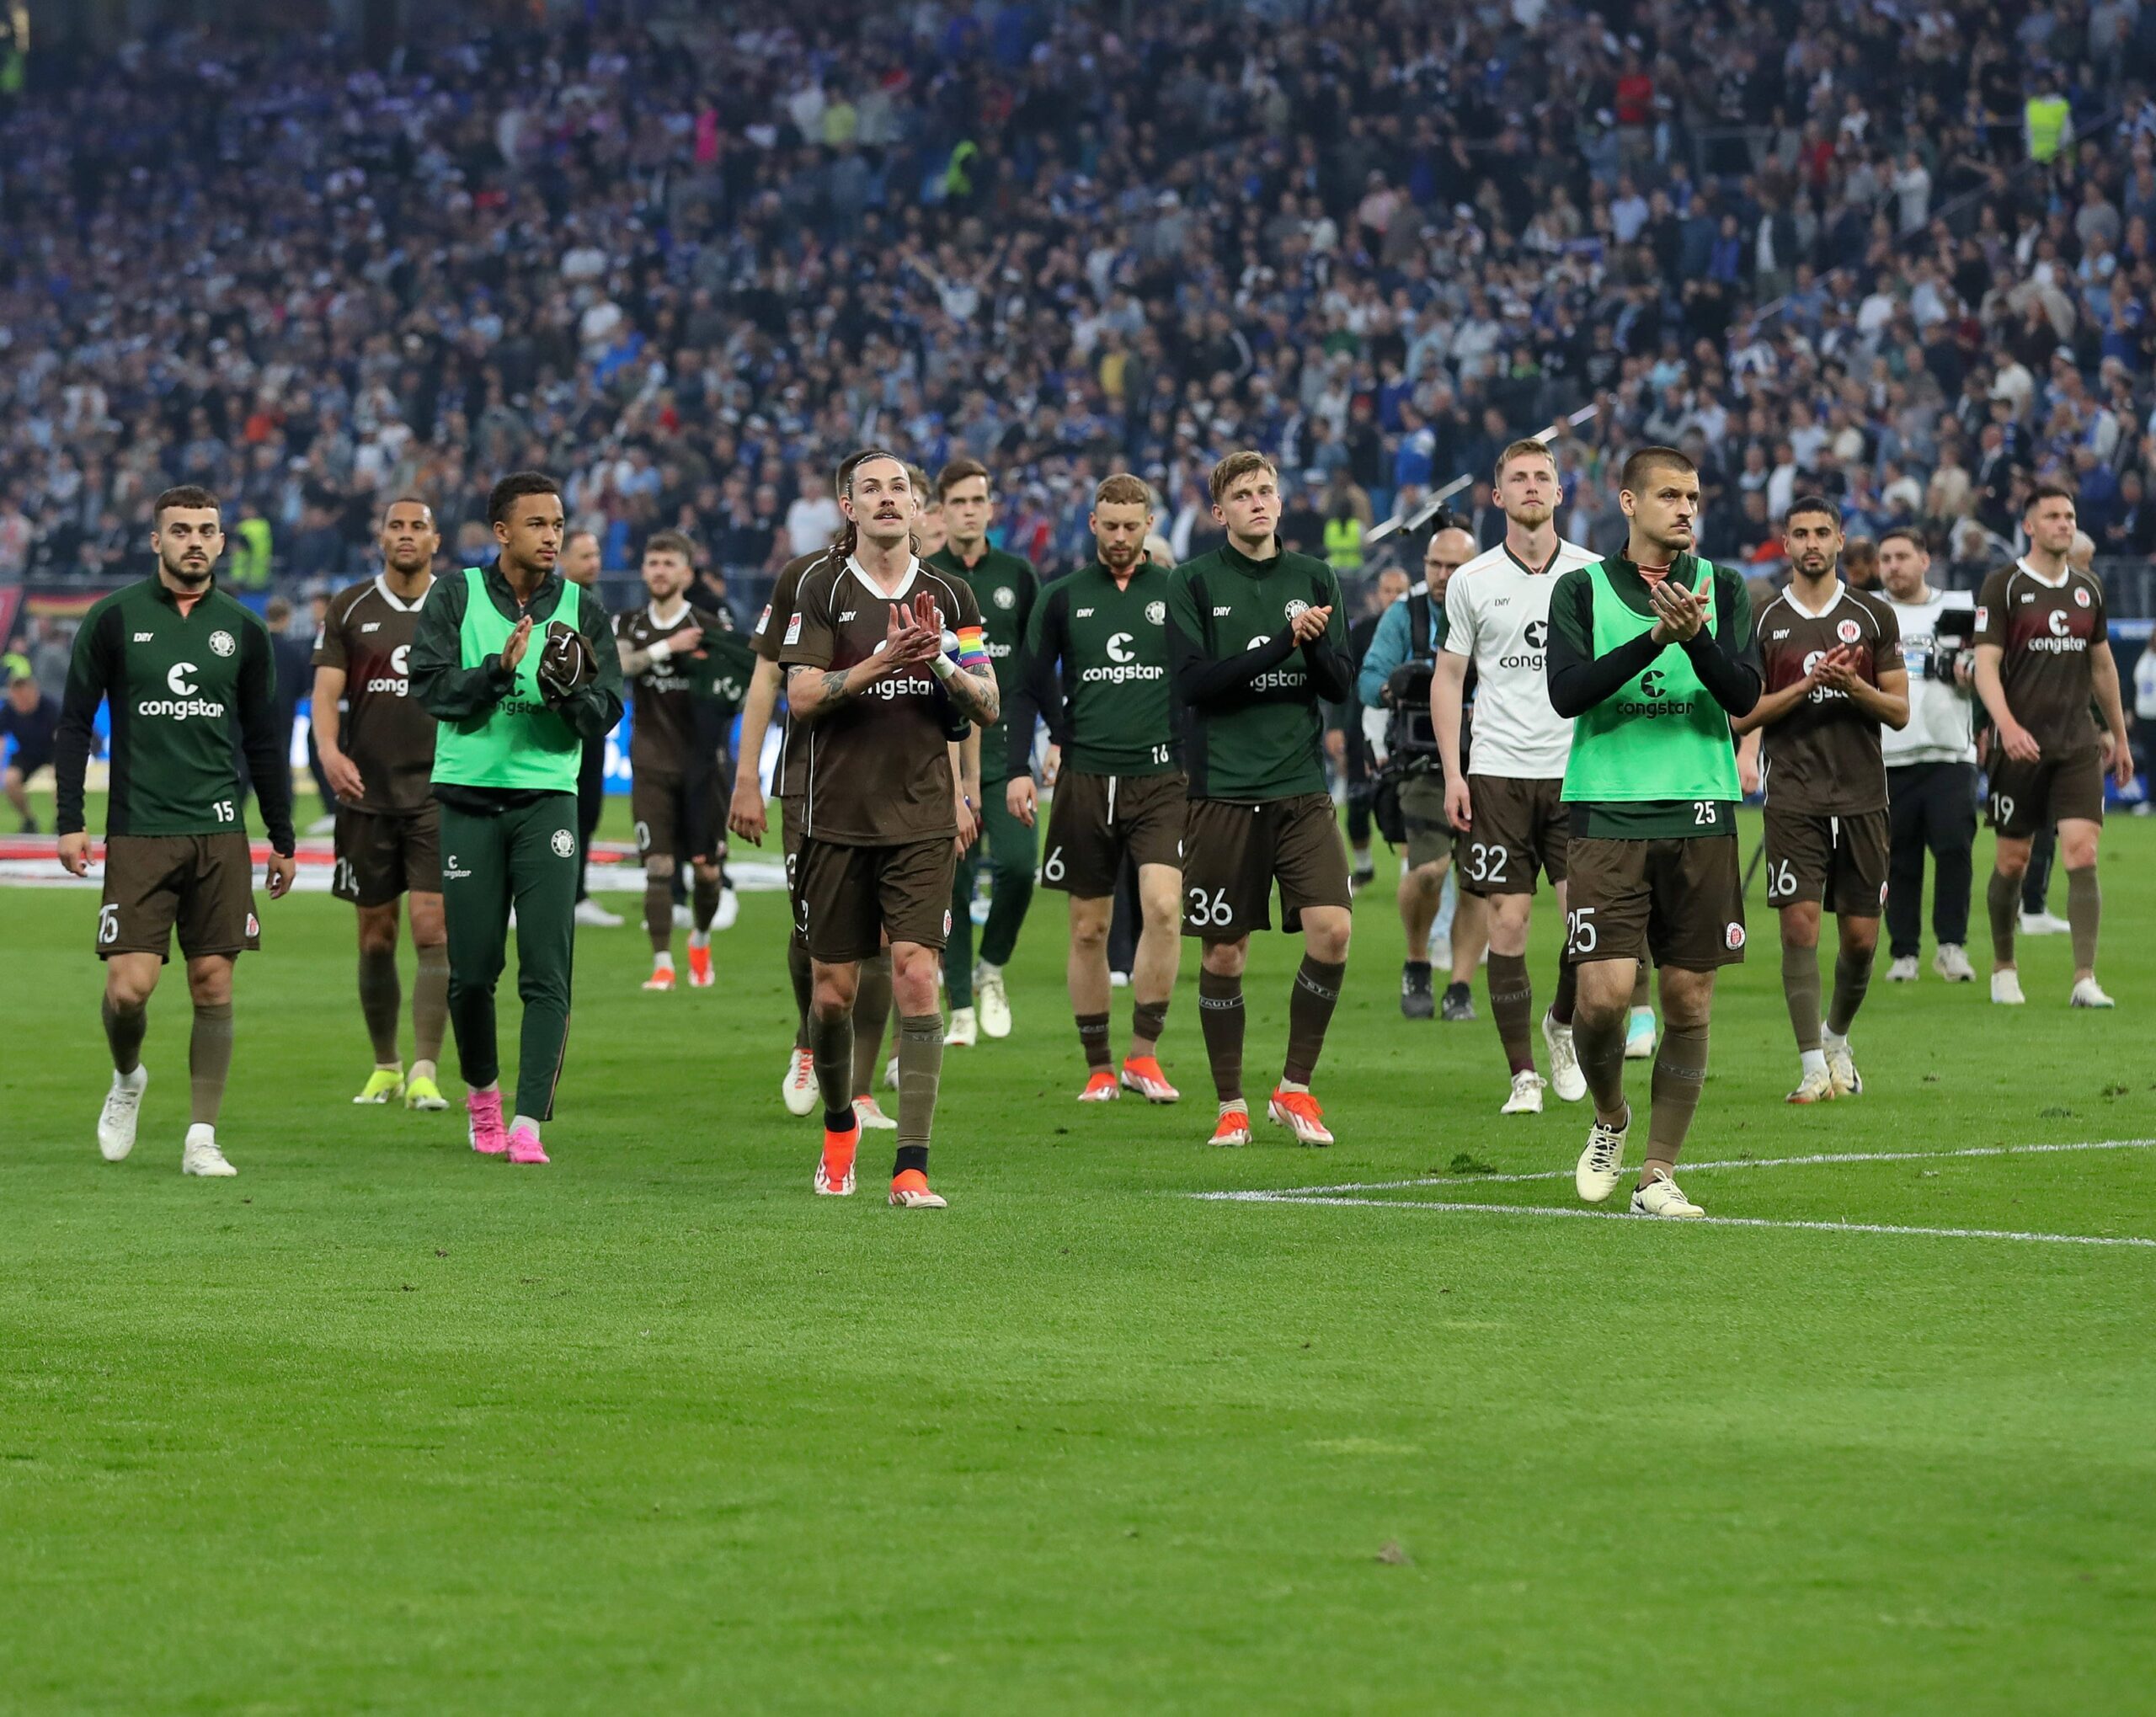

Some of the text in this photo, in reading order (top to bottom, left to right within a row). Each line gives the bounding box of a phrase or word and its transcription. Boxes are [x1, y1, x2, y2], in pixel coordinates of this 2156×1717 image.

[1082, 663, 1164, 685] congstar
[138, 697, 226, 721] congstar
[1616, 701, 1694, 720] congstar
[1151, 744, 1169, 765] 16
[212, 801, 235, 822] 15
[1694, 801, 1716, 824] 25
[1990, 792, 2015, 825] 19
[1045, 845, 1065, 882] 6
[1471, 843, 1508, 883] 32
[1768, 859, 1798, 898] 26
[1188, 888, 1233, 926] 36
[1567, 907, 1597, 954] 25
